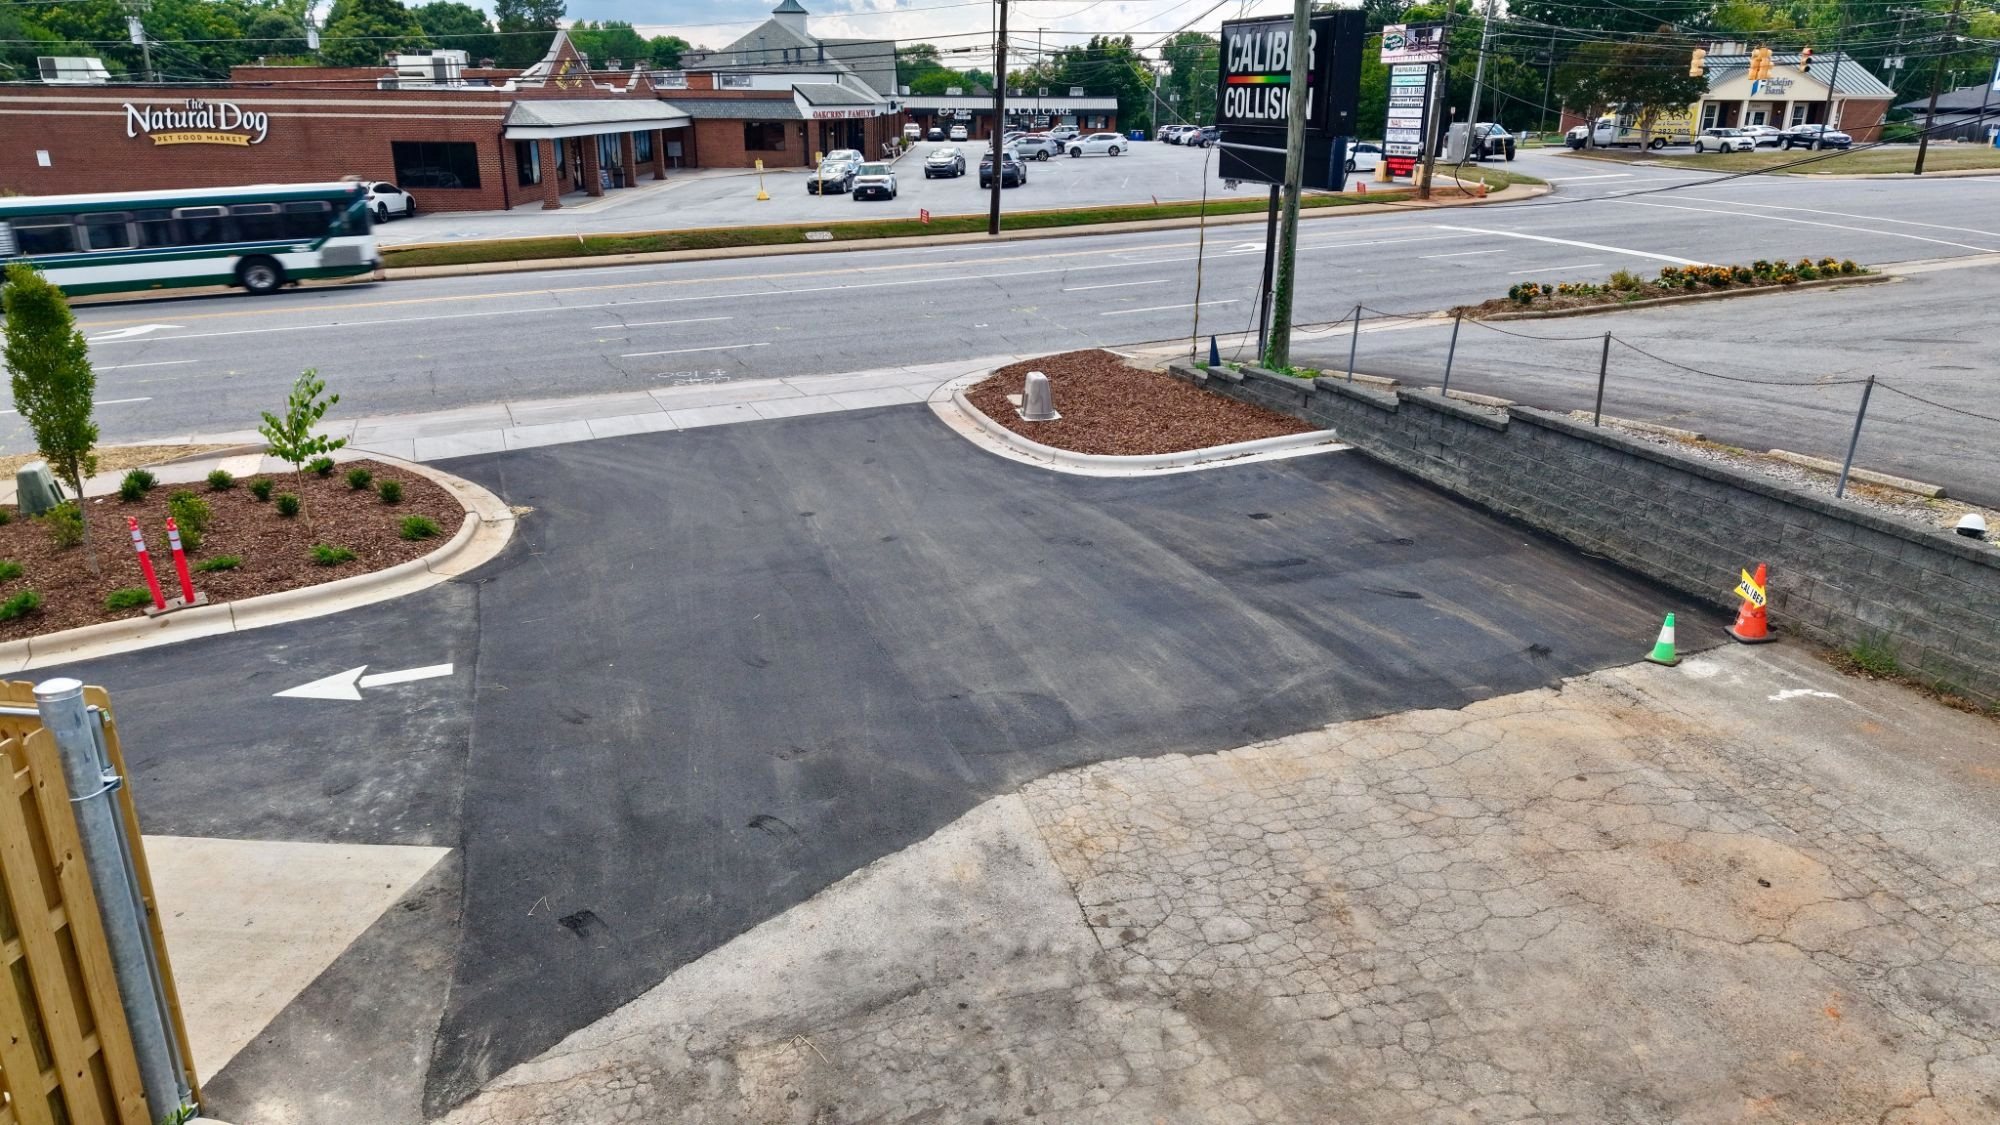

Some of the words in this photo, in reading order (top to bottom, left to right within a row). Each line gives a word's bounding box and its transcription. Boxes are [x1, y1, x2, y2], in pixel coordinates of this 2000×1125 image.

[1766, 77, 1795, 89] Fidelity
[1765, 86, 1786, 95] Bank
[184, 98, 204, 109] The
[1224, 87, 1314, 120] COLLISIN
[812, 111, 846, 119] OAKCREST
[848, 109, 870, 118] FAMILY
[1041, 107, 1072, 116] CARE
[122, 103, 216, 138] Natural
[219, 102, 269, 144] Dog
[206, 135, 242, 143] MARKET
[1740, 580, 1763, 605] CALIBER
